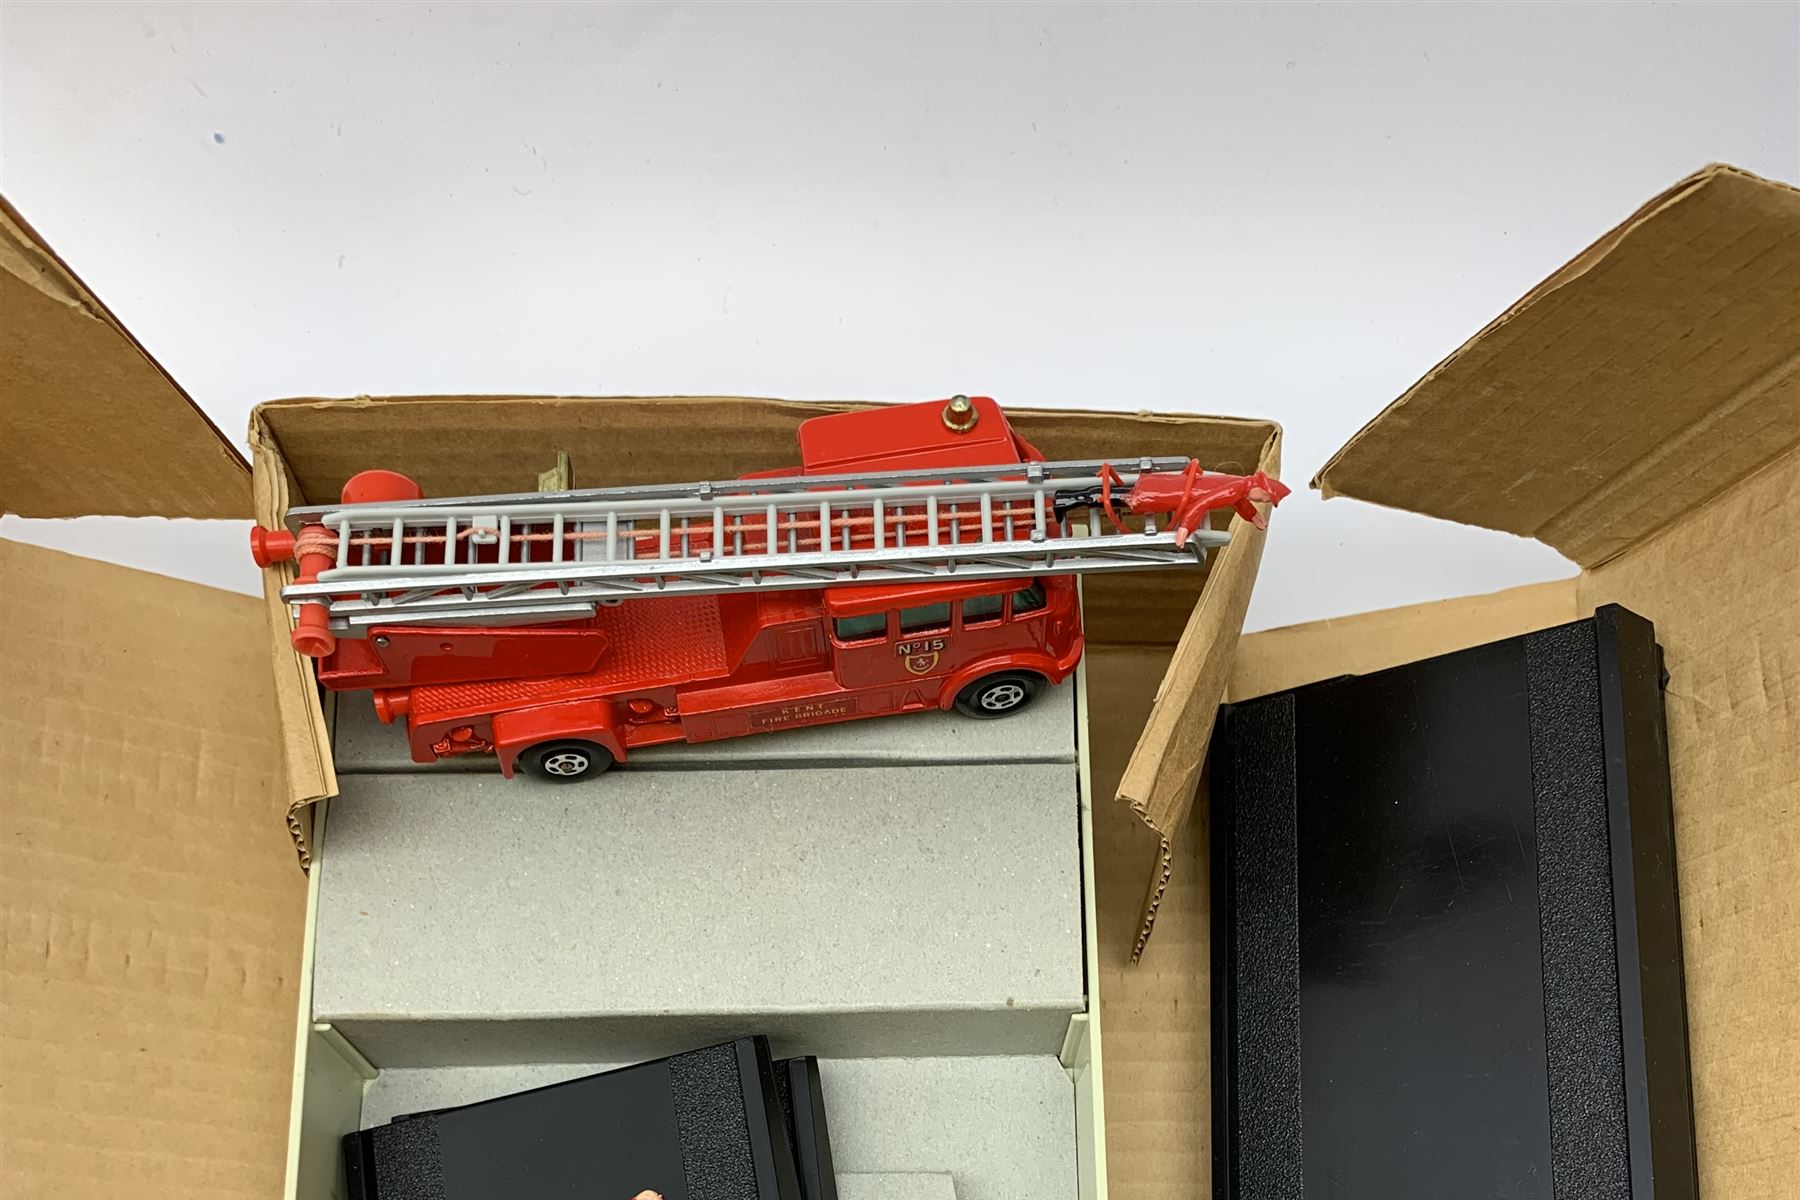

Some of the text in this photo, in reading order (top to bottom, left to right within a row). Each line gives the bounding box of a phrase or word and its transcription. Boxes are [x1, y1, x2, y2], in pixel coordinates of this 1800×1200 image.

[761, 707, 847, 725] FIRE BRIGADE
[782, 703, 824, 715] KENT
